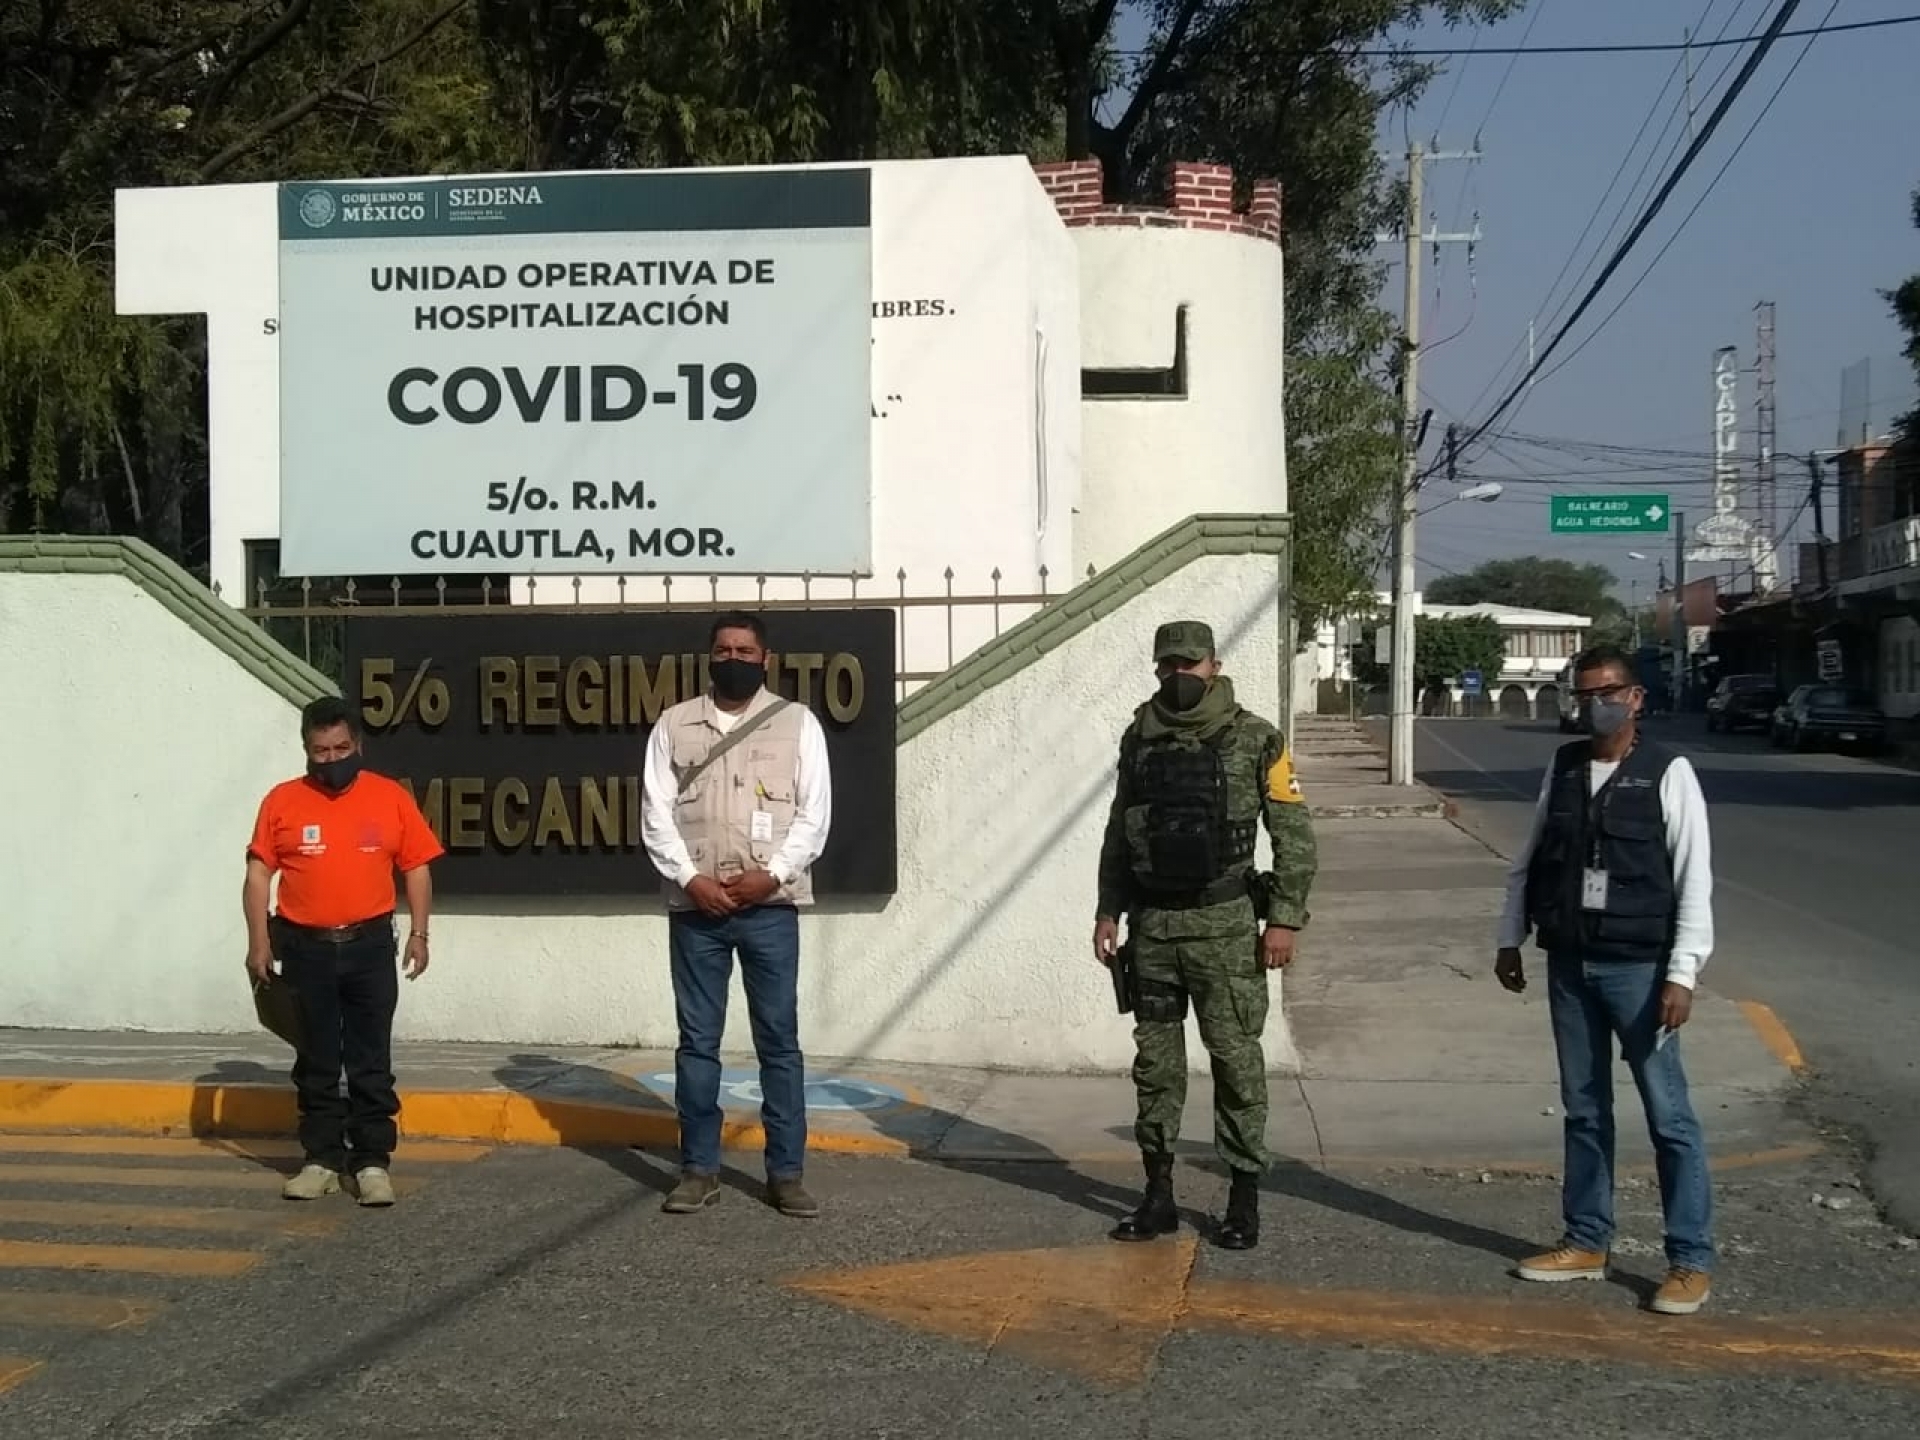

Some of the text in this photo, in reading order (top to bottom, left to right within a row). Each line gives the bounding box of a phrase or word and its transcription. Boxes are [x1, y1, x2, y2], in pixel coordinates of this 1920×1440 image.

[341, 191, 424, 205] GOBIERNO DE
[449, 185, 543, 207] SEDENA
[342, 204, 425, 222] MÉXICO
[371, 259, 775, 292] UNIDAD OPERATIVA DE
[415, 294, 729, 331] HOSPITALIZACIÓN
[872, 299, 955, 319] IBRES.
[387, 362, 757, 426] COVID-19
[486, 476, 657, 514] 5/o. R.M.
[1568, 502, 1629, 511] BALNEARIO
[1556, 516, 1584, 526] AGUA
[410, 527, 735, 563] CUAUTLA, MOR.
[480, 653, 865, 726] REGIMITO
